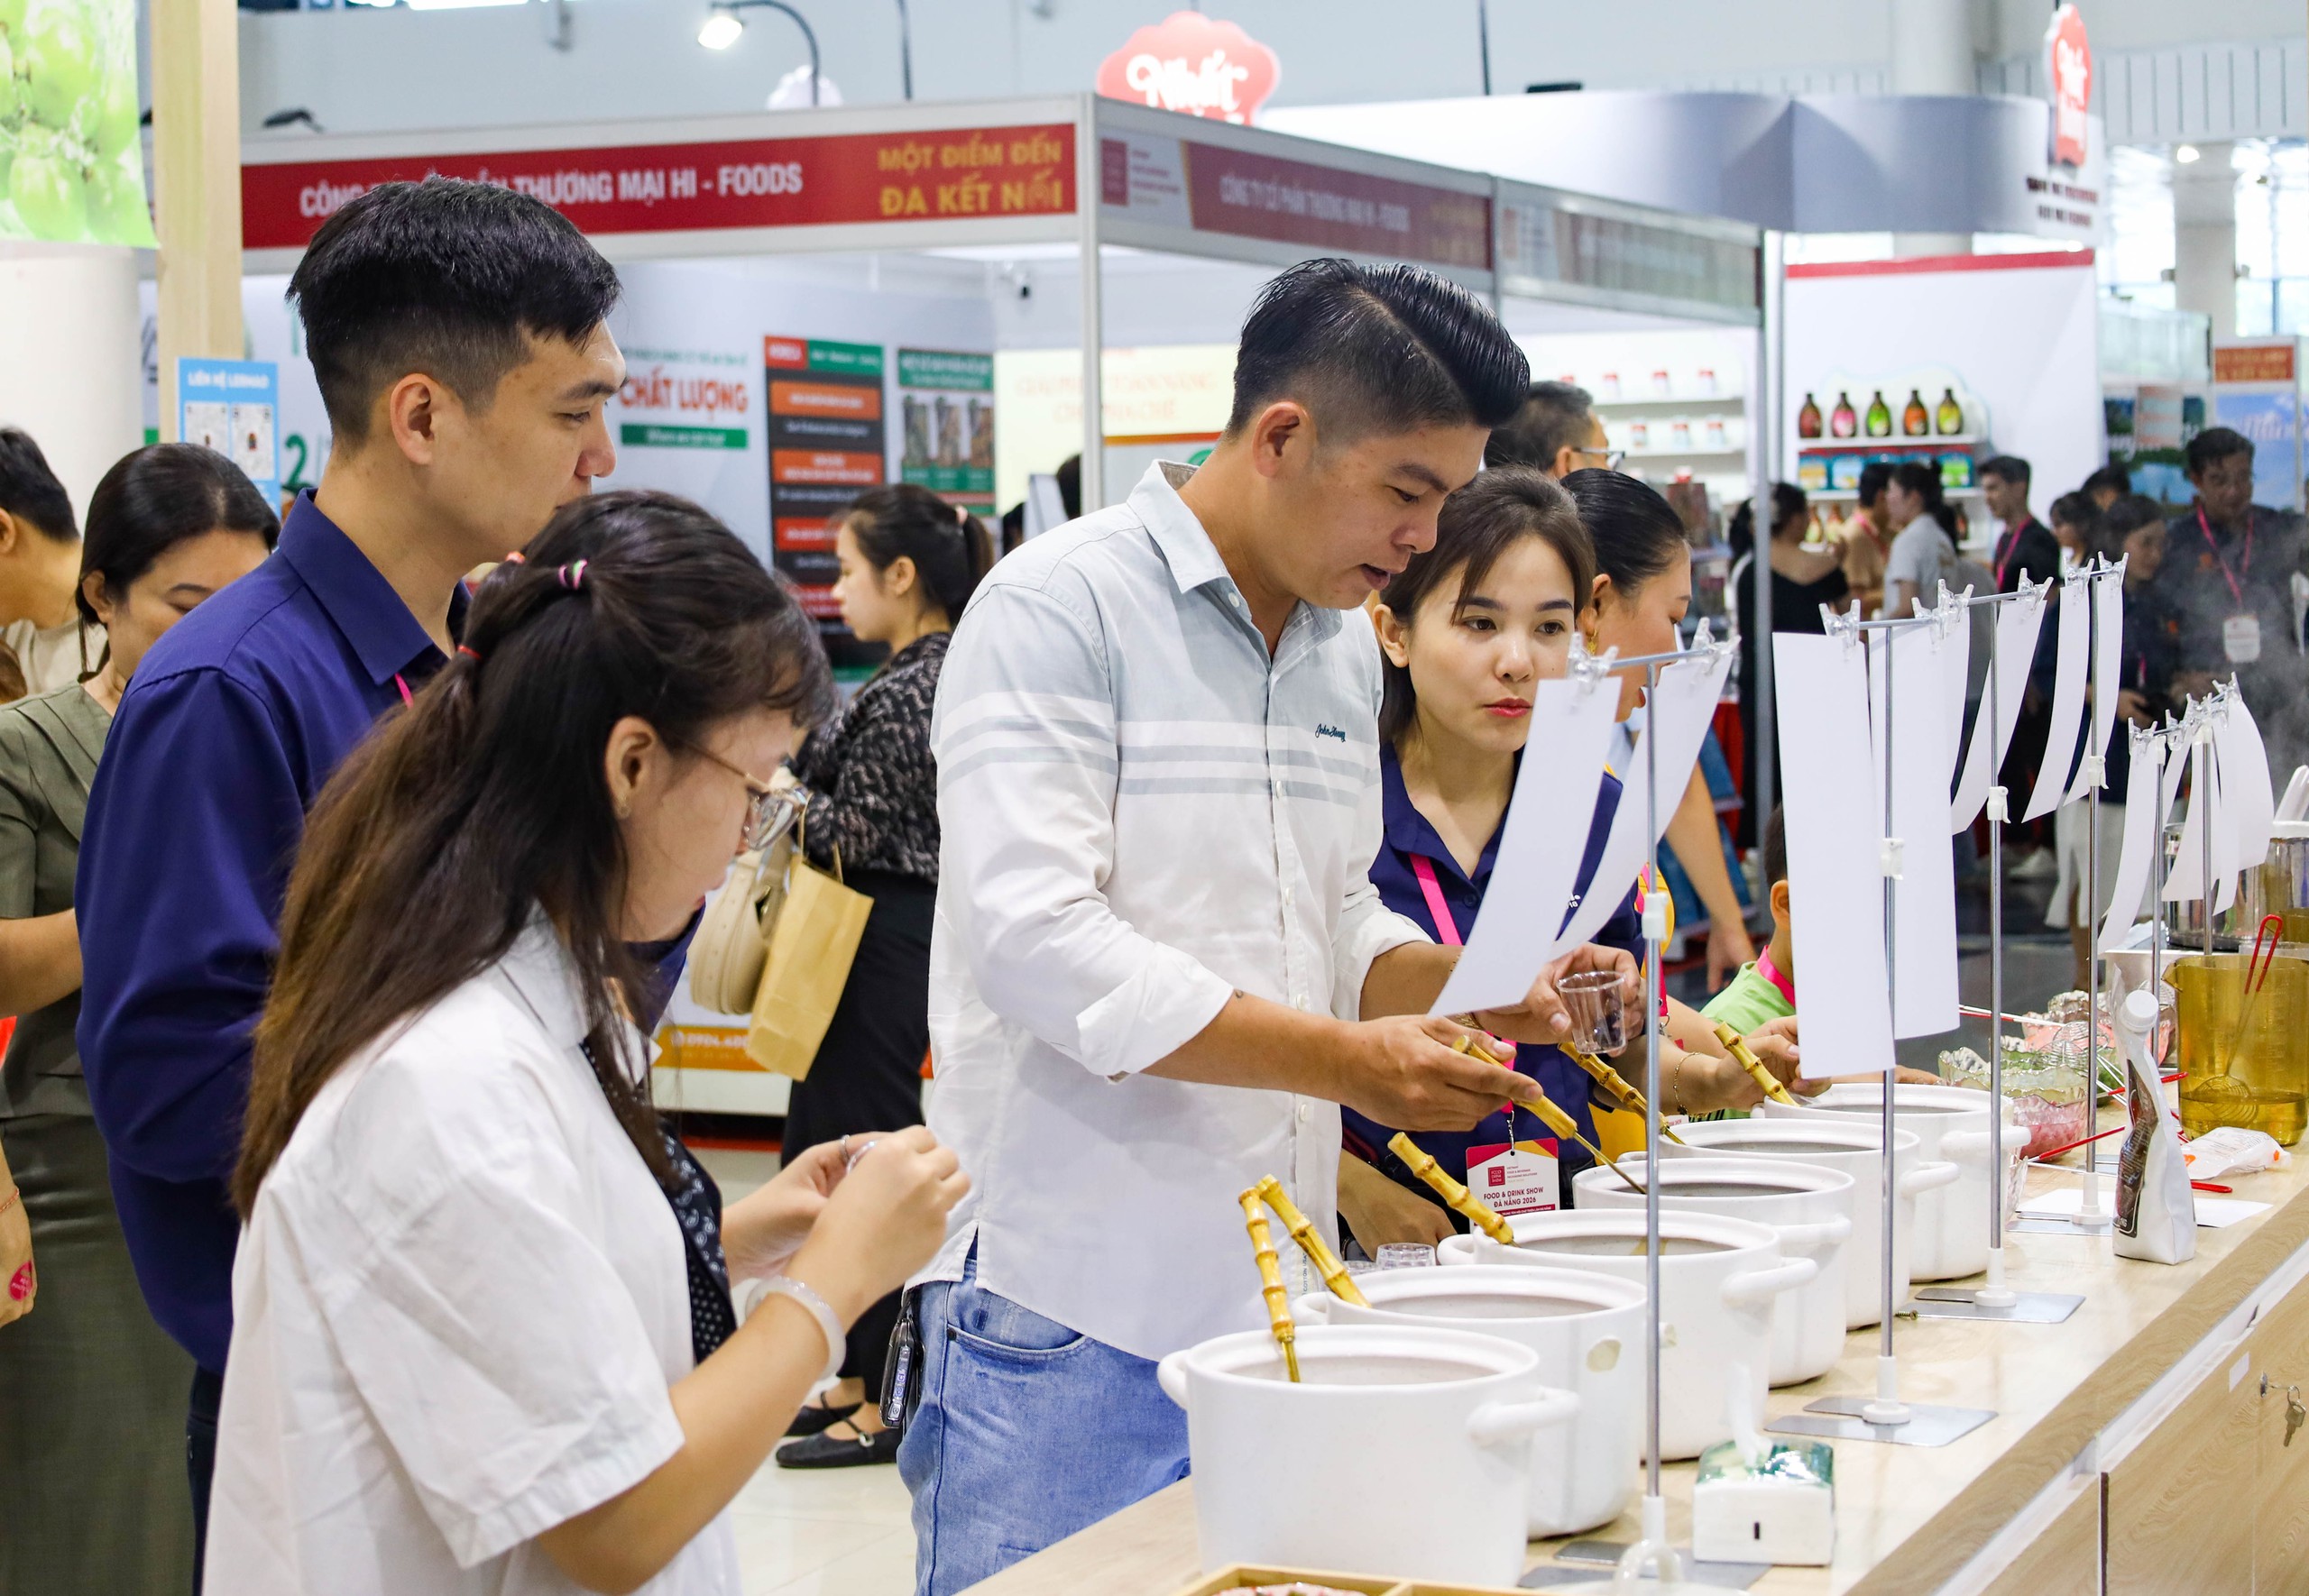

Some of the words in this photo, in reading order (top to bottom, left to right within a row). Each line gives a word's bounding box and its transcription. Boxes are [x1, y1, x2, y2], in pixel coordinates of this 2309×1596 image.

[877, 141, 934, 176] MỘT
[1009, 132, 1063, 166] ĐẾN
[618, 169, 666, 206] MẠI
[670, 168, 697, 199] HI
[718, 163, 803, 196] FOODS
[938, 171, 991, 213] KẾT
[1484, 1192, 1500, 1200] FOOD
[1507, 1188, 1524, 1197] DRINK
[1526, 1187, 1543, 1195] SHOW
[1494, 1199, 1502, 1207] ĐÀ
[1504, 1197, 1521, 1206] NẴNG
[1522, 1197, 1536, 1205] 2026
